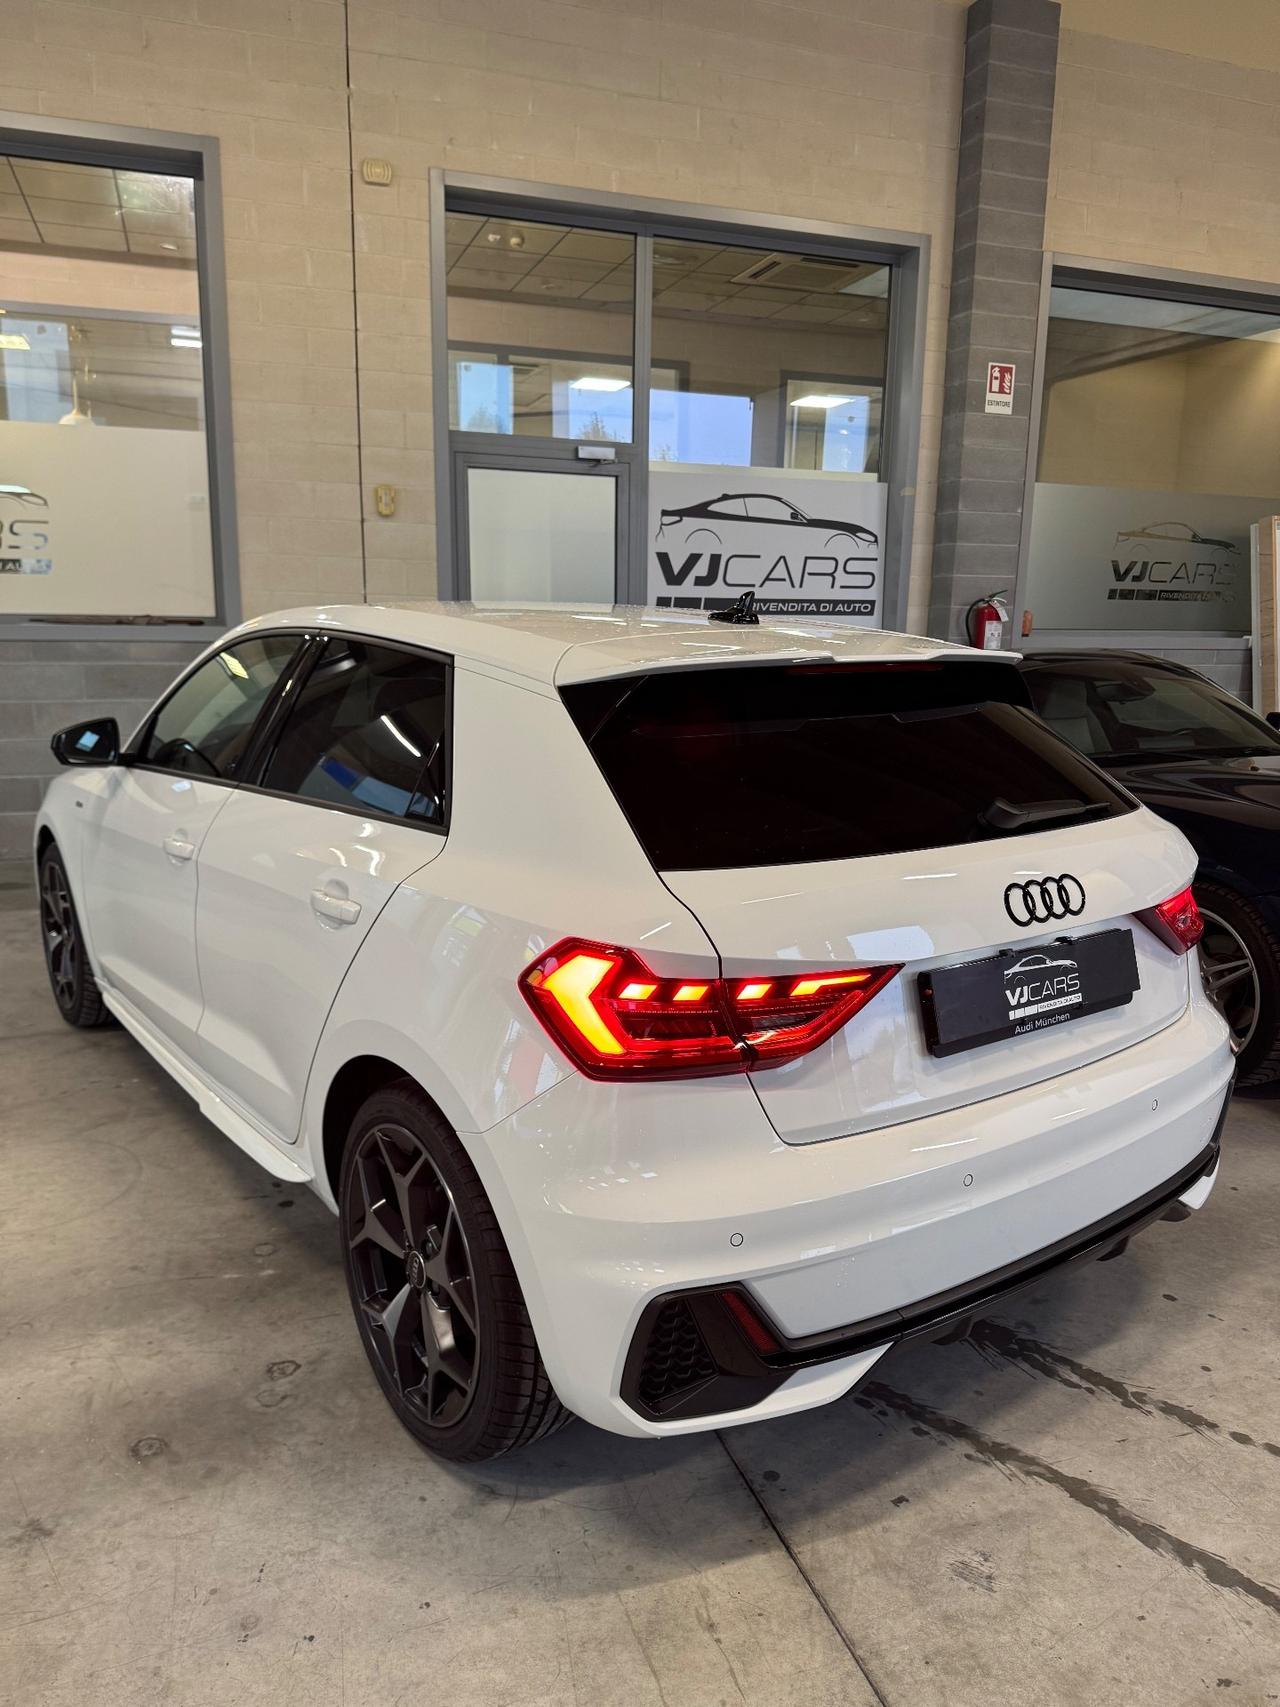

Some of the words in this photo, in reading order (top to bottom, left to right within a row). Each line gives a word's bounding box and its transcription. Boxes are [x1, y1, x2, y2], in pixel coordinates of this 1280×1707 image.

[987, 399, 1011, 408] ESTINTORE
[655, 552, 878, 589] VJCARS
[820, 603, 833, 612] DI
[835, 603, 872, 613] AUTO
[1005, 973, 1080, 1006] VJCARS
[1014, 1022, 1034, 1034] Audi
[1035, 1013, 1070, 1028] München
